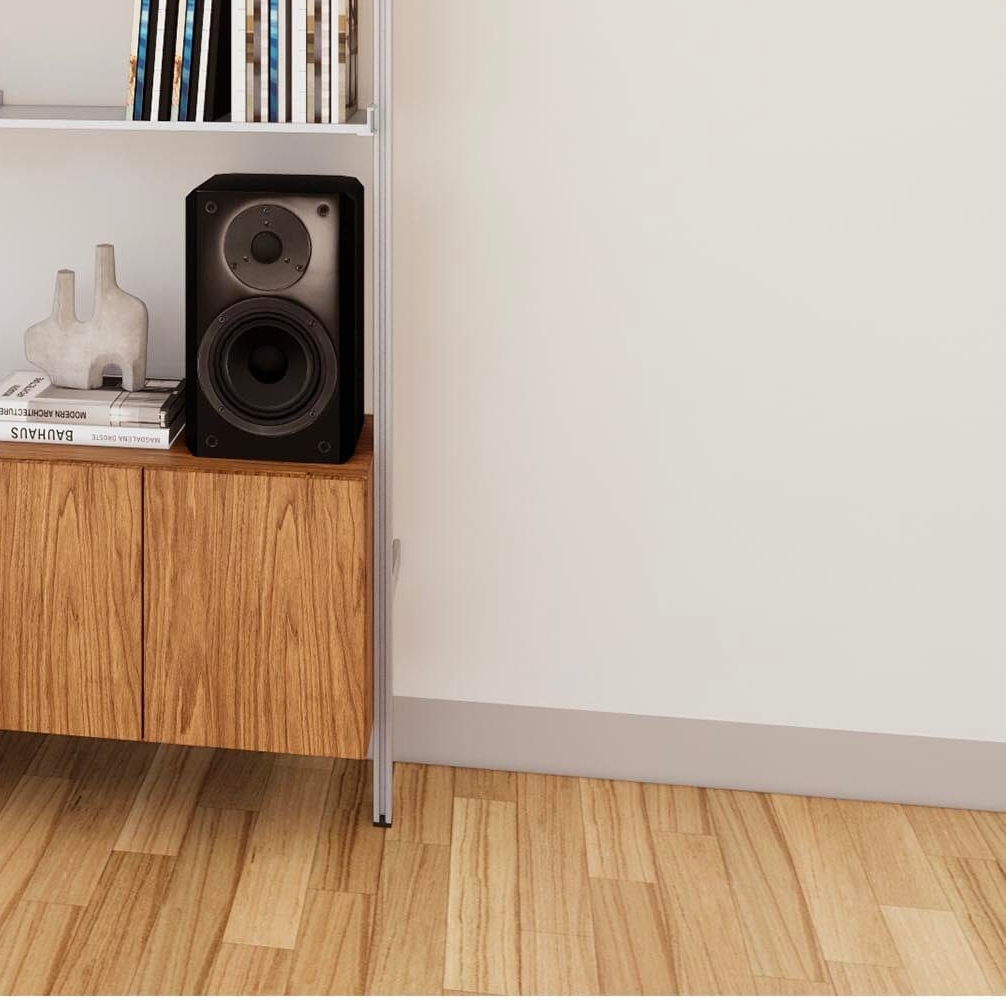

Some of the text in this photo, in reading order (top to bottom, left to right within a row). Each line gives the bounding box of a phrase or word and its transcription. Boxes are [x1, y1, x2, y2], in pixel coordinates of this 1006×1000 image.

[0, 407, 87, 420] MODERN ARCHITECTURE
[10, 427, 73, 442] BAUHAUS
[91, 433, 161, 444] MAGDALENA DROSTE
